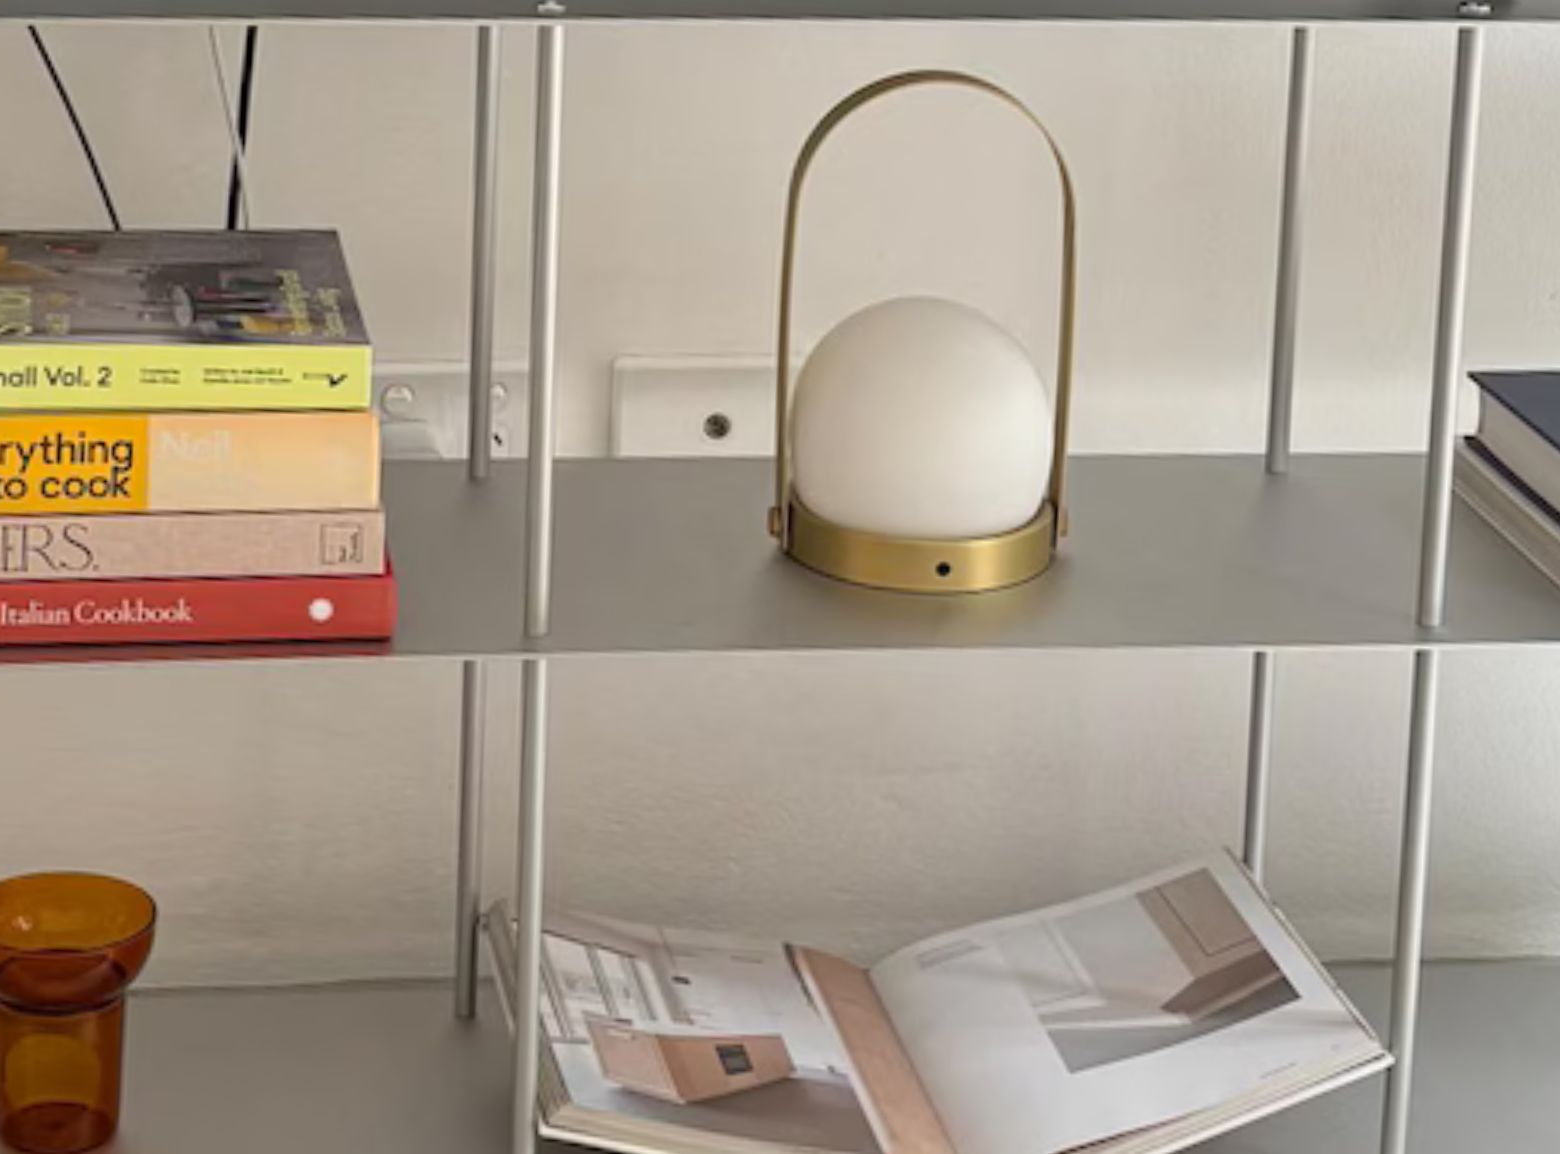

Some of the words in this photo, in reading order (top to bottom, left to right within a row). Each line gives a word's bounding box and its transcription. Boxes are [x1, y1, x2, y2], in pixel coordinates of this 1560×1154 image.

[43, 366, 90, 388] Vol.
[97, 366, 113, 388] 2
[40, 466, 131, 499] cook
[0, 599, 71, 626] Italian
[73, 597, 194, 626] Cookbook
